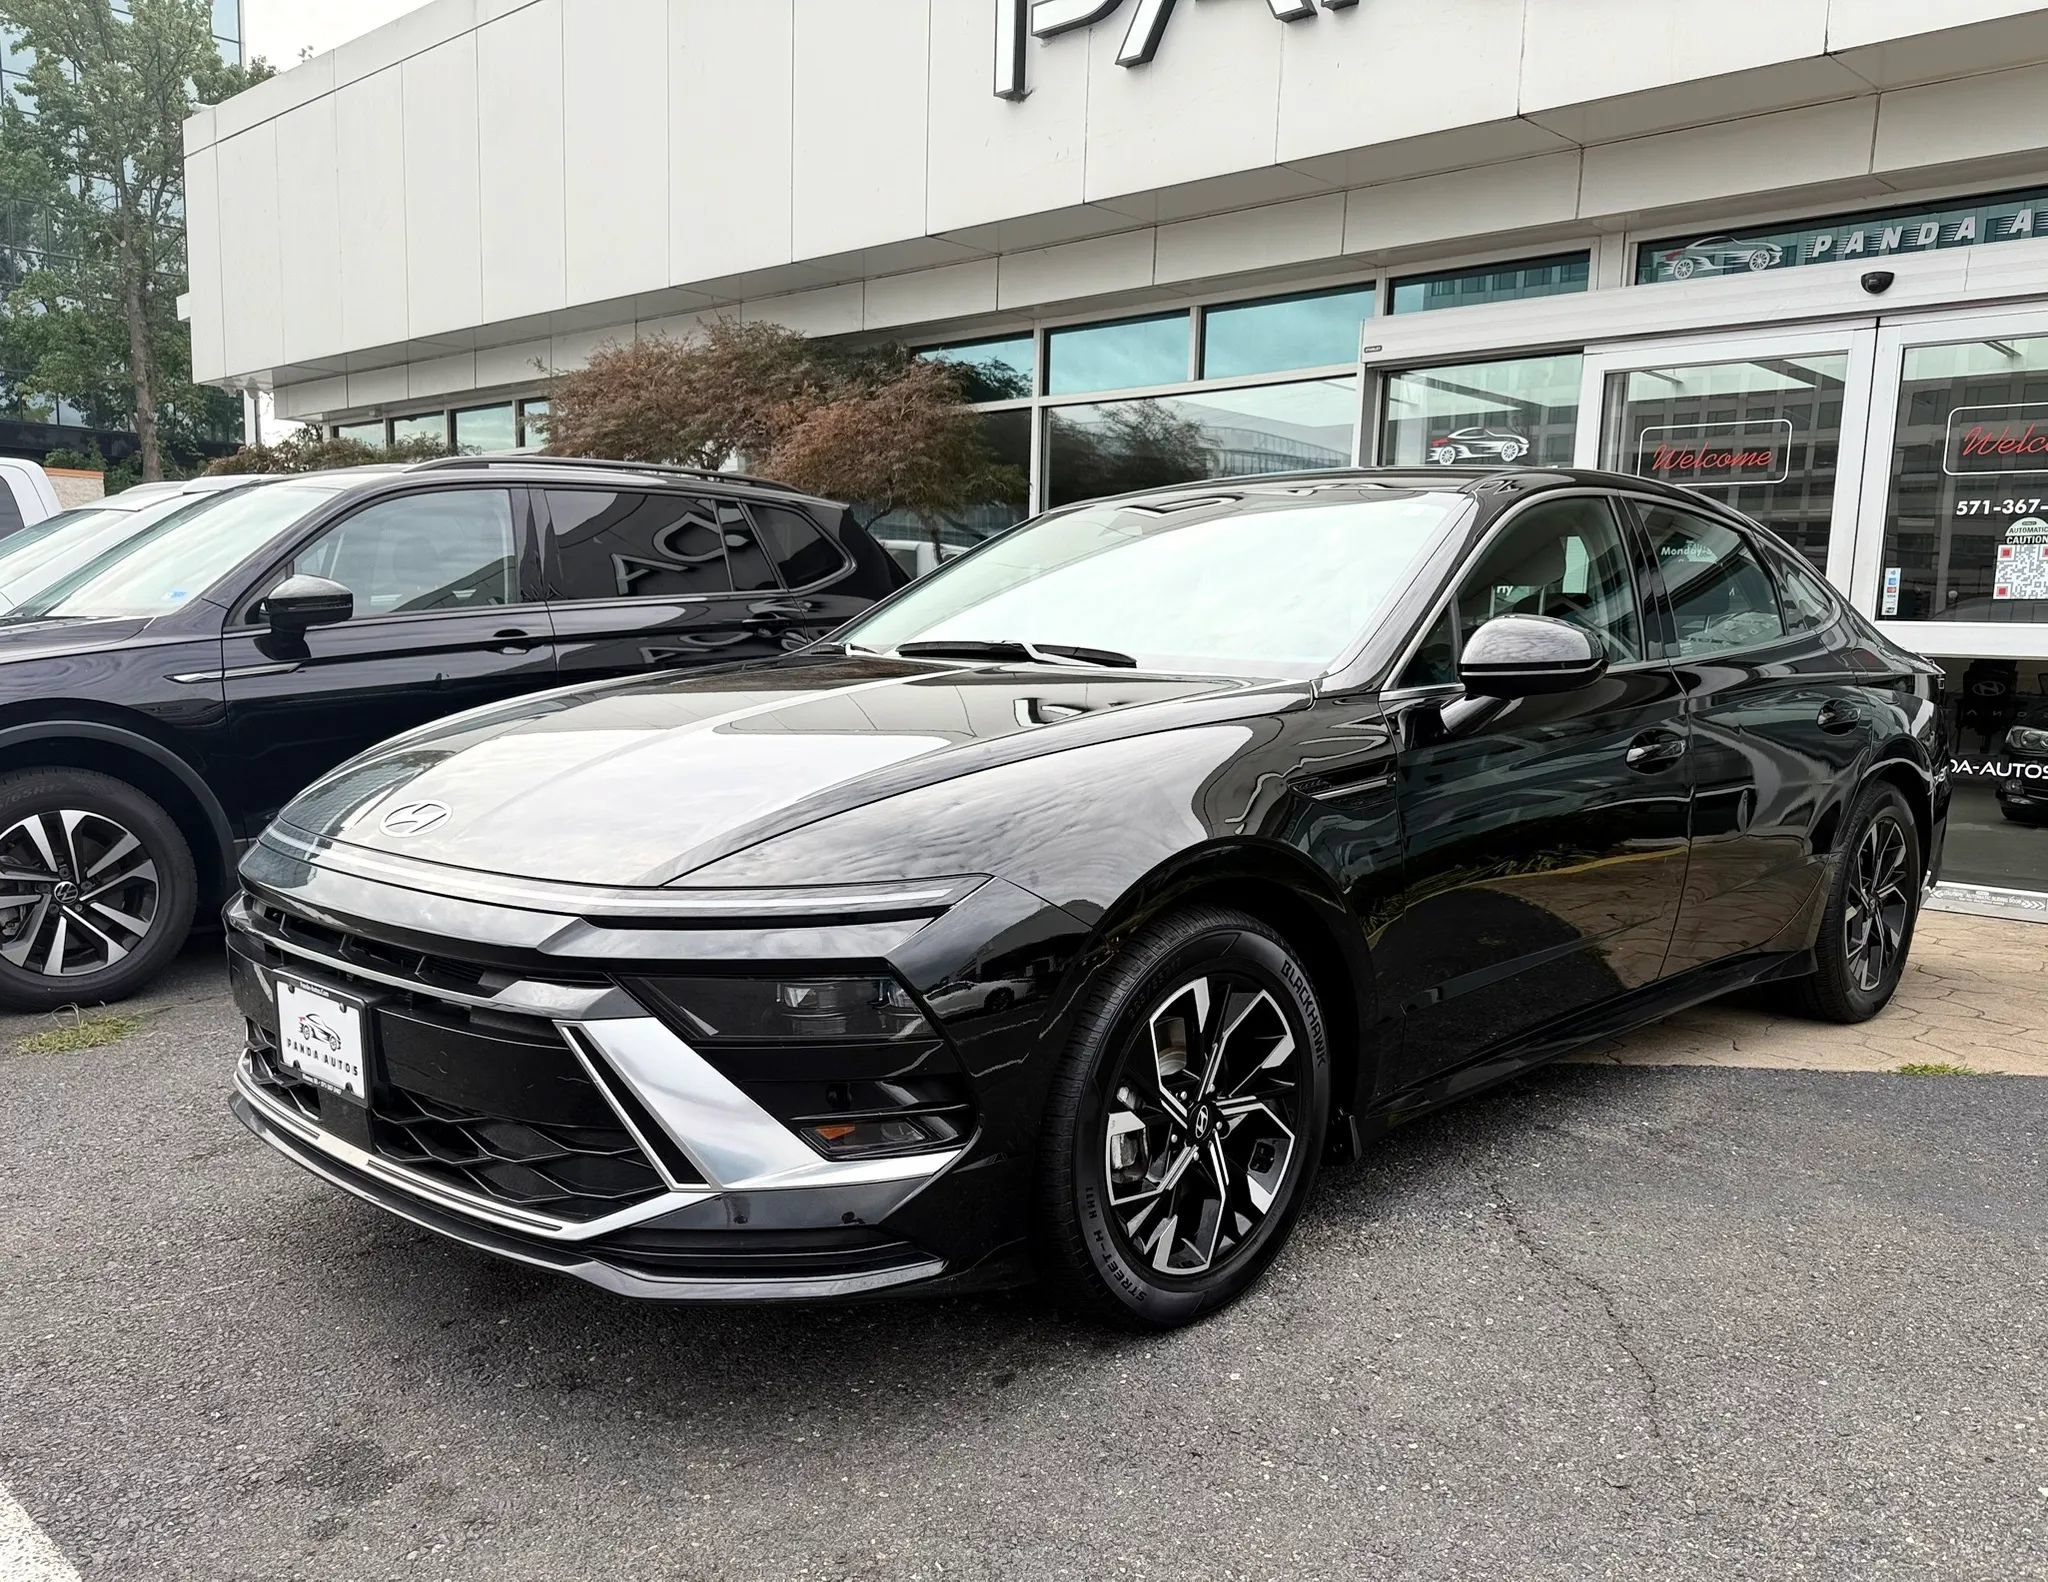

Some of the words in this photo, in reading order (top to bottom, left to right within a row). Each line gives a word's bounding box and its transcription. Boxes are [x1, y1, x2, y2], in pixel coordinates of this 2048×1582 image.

[1807, 216, 1976, 258] PANDA
[1652, 441, 1773, 471] Welcome
[1963, 424, 2048, 456] Welc
[2006, 535, 2048, 545] CAUTION
[1281, 960, 1327, 1069] BLACKHAWK
[287, 1038, 319, 1061] PANDA
[324, 1054, 358, 1076] AUTOS
[1093, 1229, 1148, 1302] STREET-H
